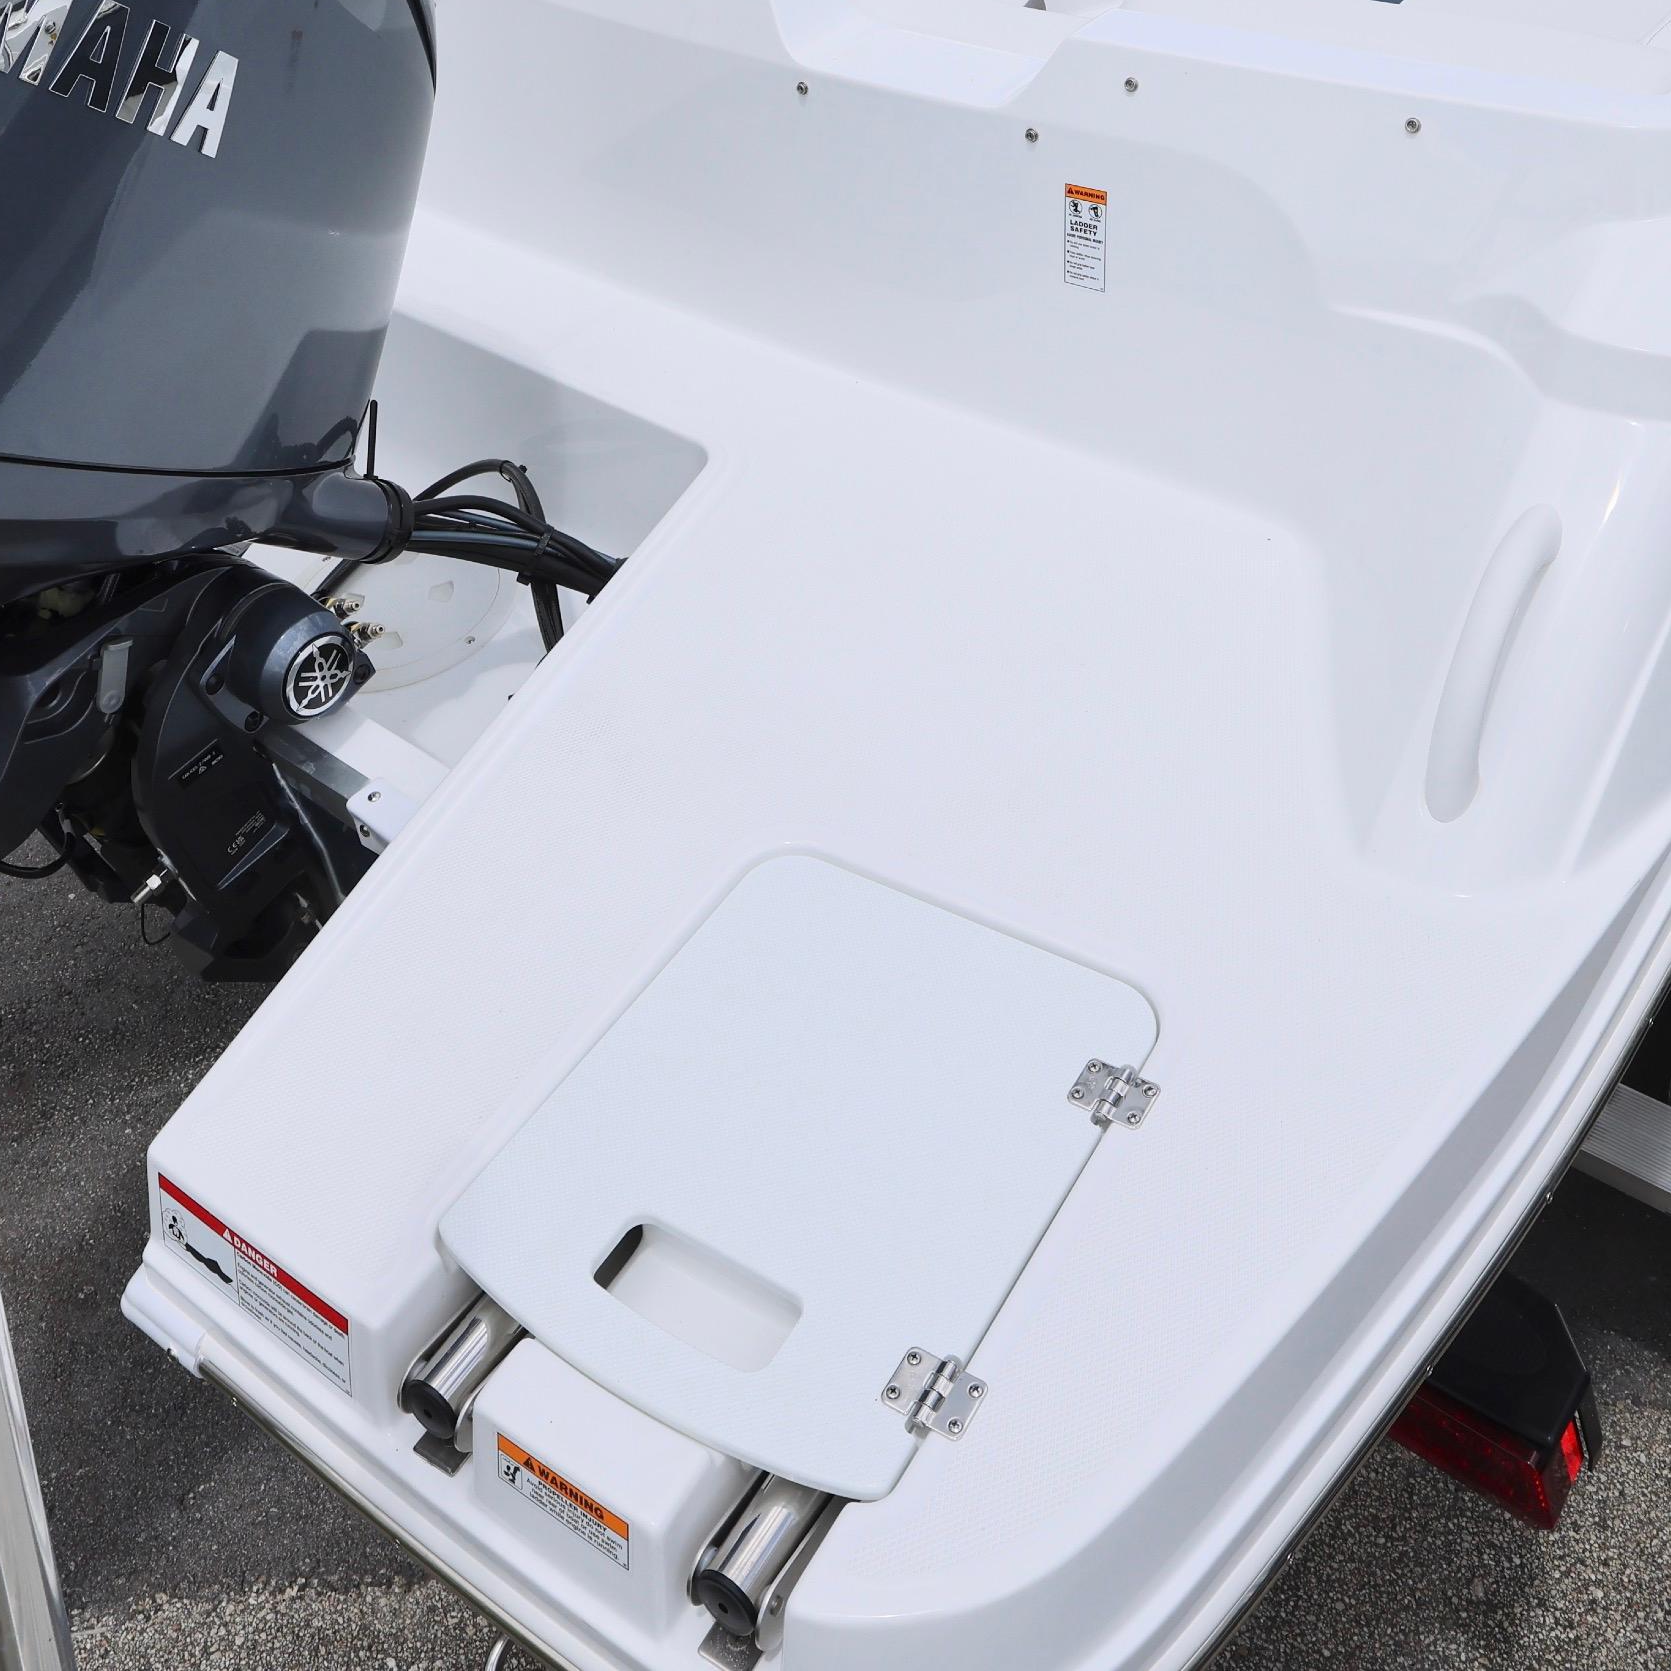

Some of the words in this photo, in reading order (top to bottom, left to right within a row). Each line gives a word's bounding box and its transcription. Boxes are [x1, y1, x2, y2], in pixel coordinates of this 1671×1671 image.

[1074, 189, 1105, 201] WARNING
[1070, 219, 1098, 231] LADDER
[1070, 226, 1098, 237] SAFETY
[233, 1235, 278, 1277] DANGER
[537, 1463, 604, 1522] WARNING
[537, 1479, 578, 1513] PROPELLER
[580, 1509, 607, 1534] INJURY
